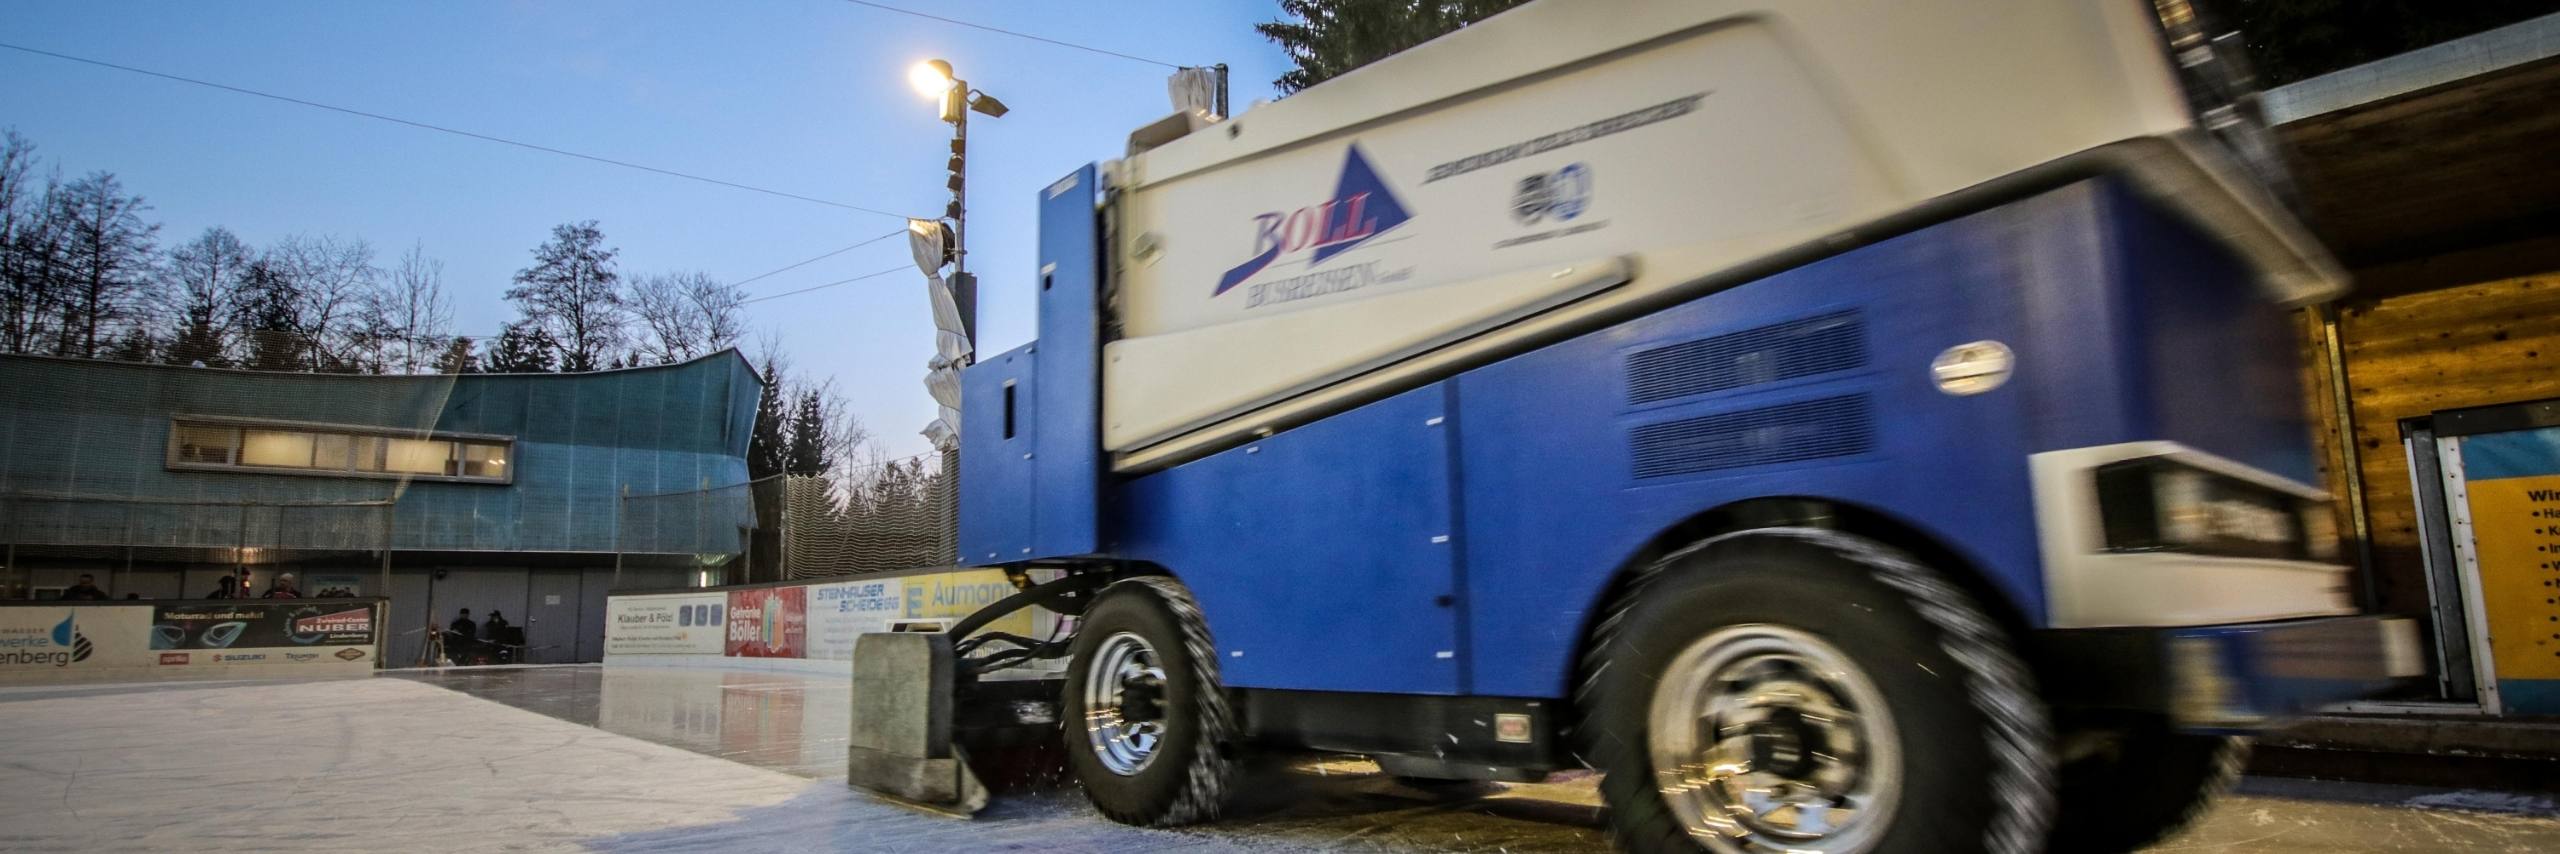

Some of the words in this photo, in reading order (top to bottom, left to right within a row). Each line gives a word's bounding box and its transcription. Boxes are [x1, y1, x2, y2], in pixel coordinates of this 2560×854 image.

[1250, 191, 1378, 256] BOLL
[214, 611, 233, 619] und
[730, 606, 761, 619] Getränke
[617, 614, 647, 624] Klauber
[299, 623, 369, 632] NUBER
[729, 620, 761, 641] Böller
